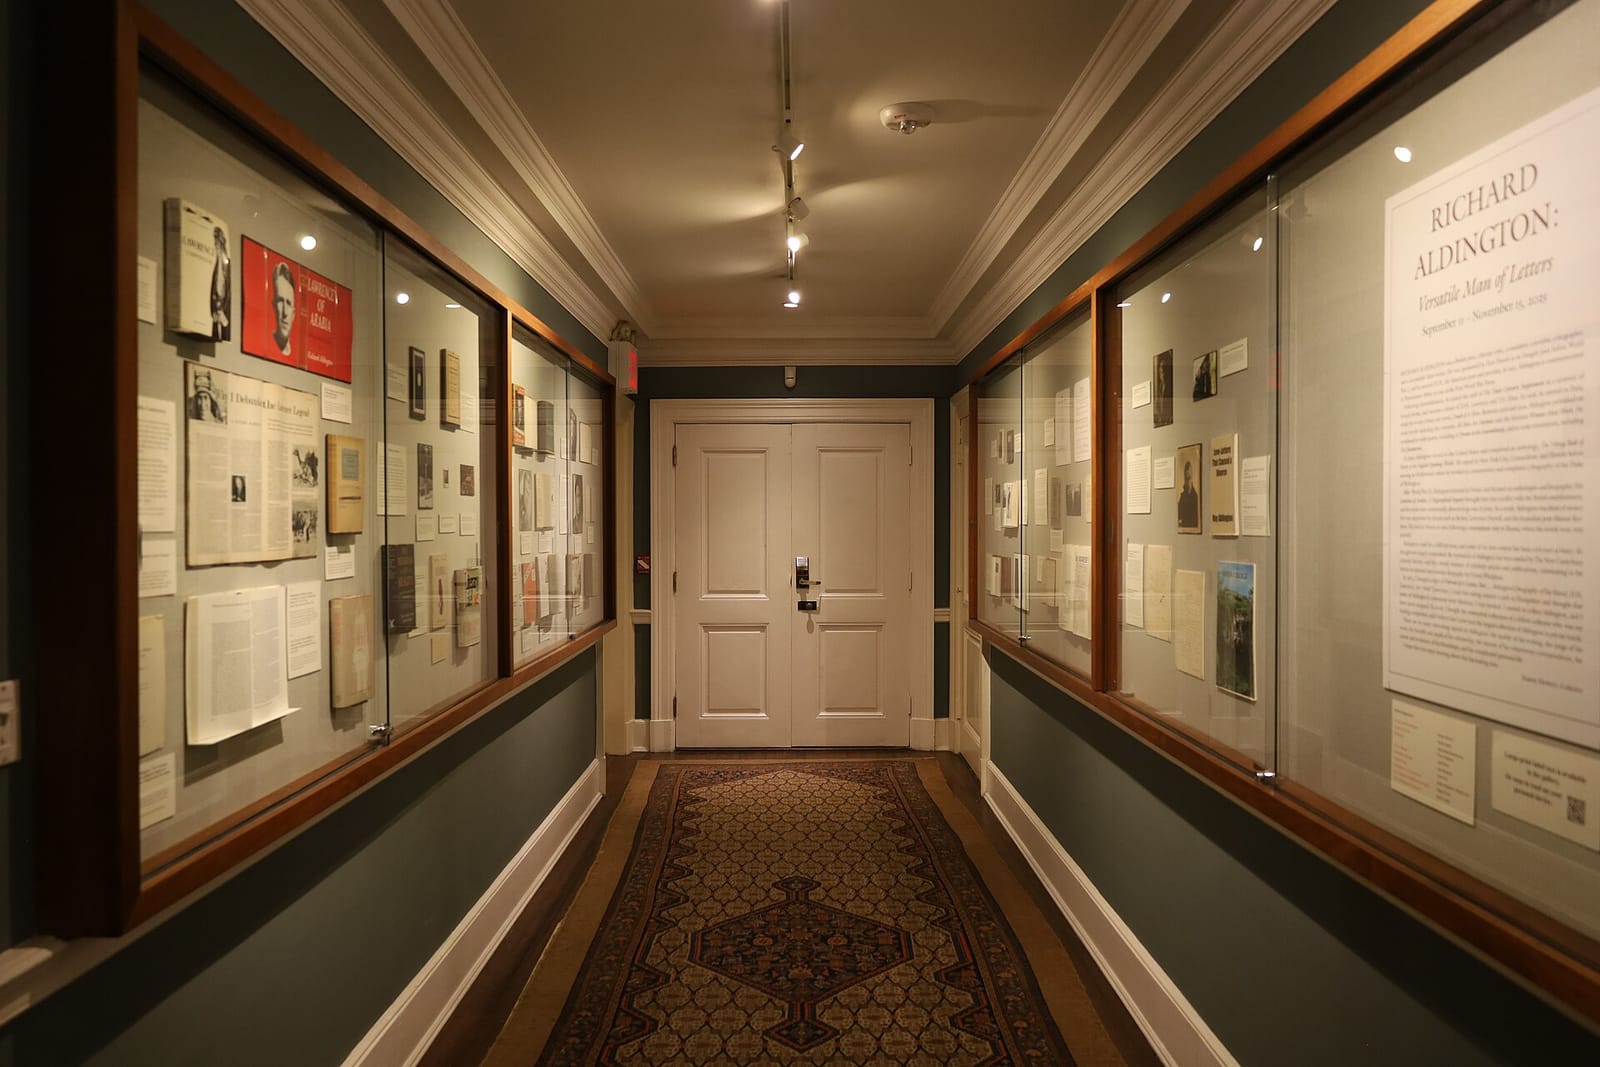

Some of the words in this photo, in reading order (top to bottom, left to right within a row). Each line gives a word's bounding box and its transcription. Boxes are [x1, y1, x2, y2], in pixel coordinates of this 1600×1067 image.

[1431, 163, 1538, 232] RICHARD
[1414, 202, 1559, 280] ALDINGTON:
[308, 278, 336, 302] LAWRENCE
[1419, 284, 1460, 312] Versatile
[1462, 278, 1491, 298] Man
[1495, 265, 1510, 293] of
[1510, 257, 1554, 283] Letters
[1422, 319, 1456, 338] September
[1472, 302, 1514, 321] November
